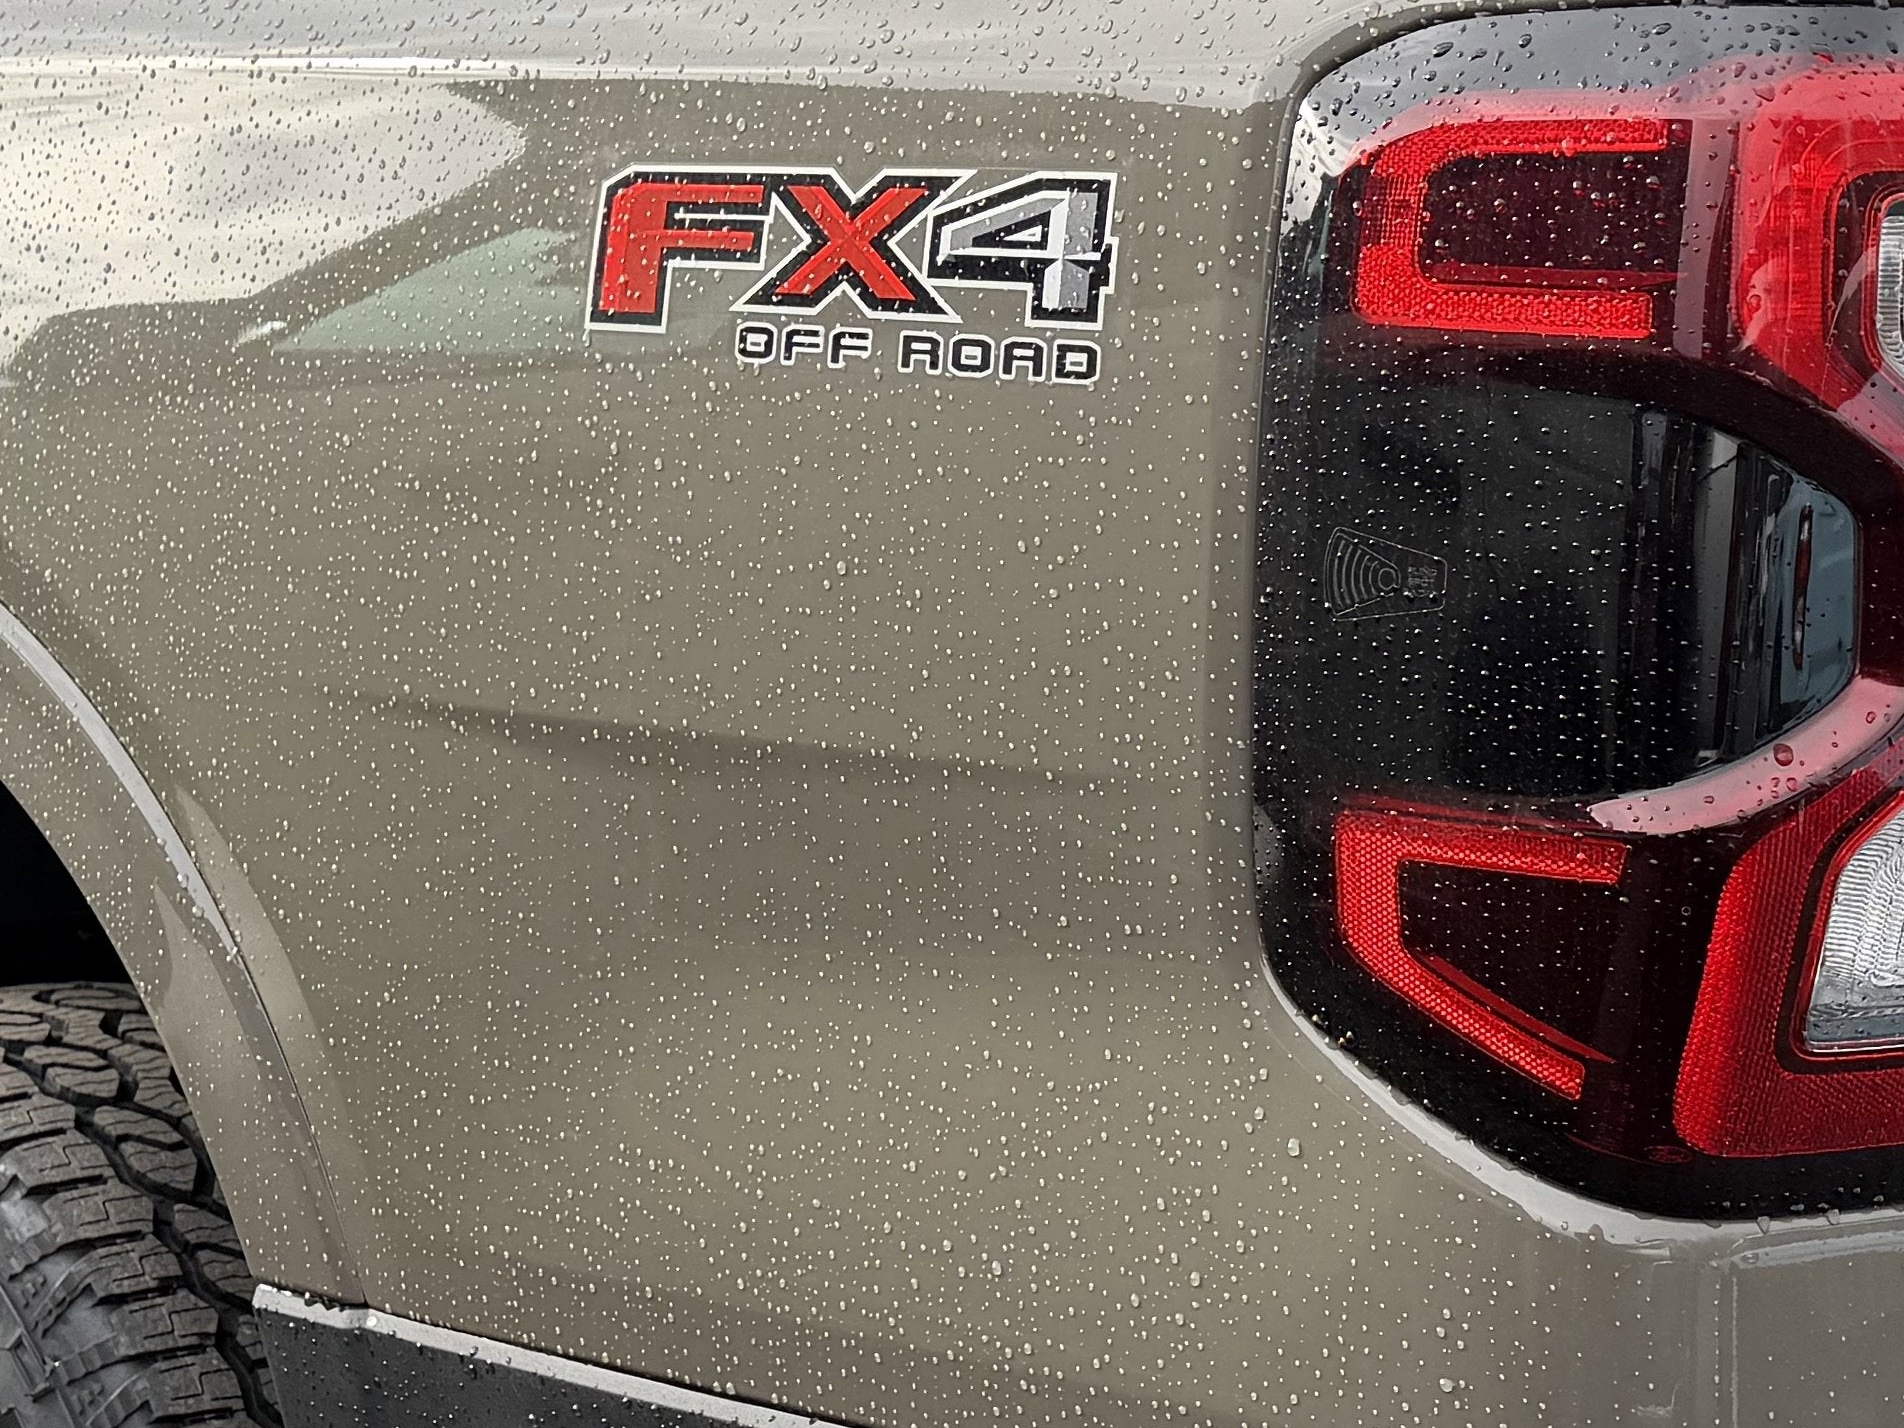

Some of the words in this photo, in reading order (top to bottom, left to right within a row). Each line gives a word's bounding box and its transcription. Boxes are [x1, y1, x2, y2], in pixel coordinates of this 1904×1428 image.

[585, 163, 1119, 333] FX4
[735, 321, 873, 367] OFF
[897, 329, 1102, 385] ROAD
